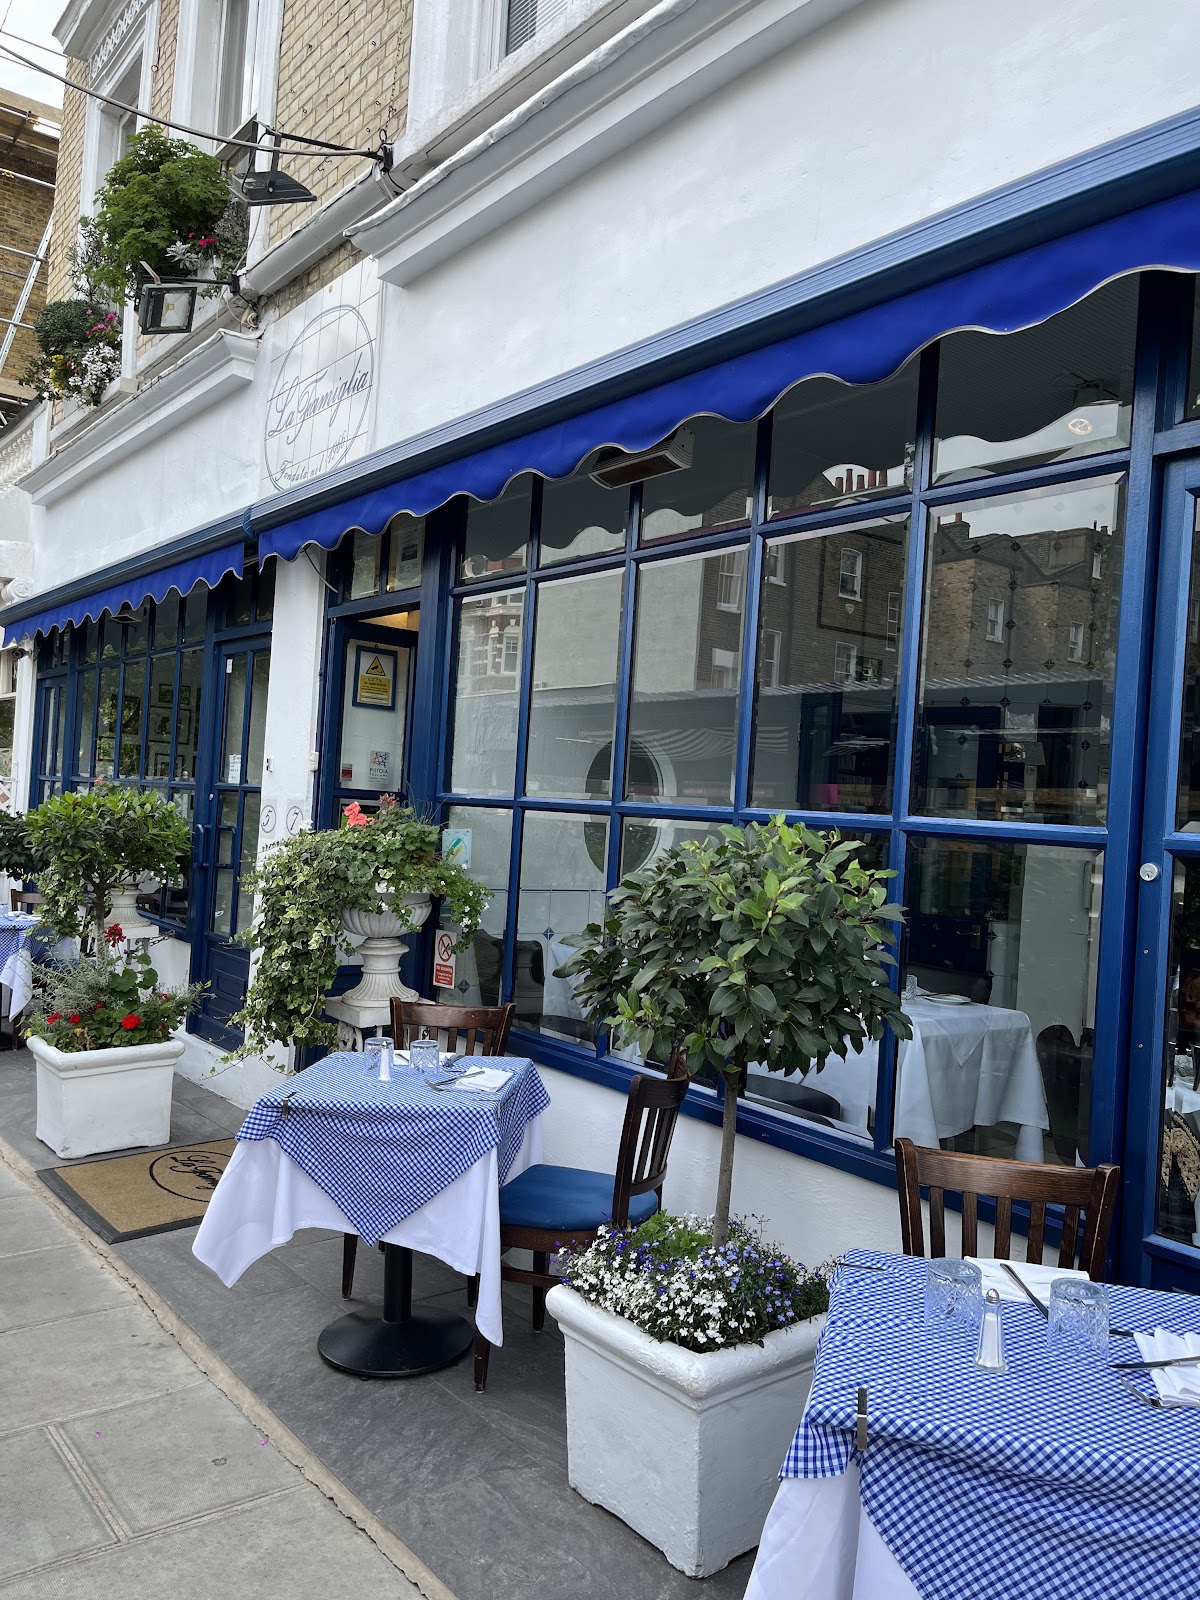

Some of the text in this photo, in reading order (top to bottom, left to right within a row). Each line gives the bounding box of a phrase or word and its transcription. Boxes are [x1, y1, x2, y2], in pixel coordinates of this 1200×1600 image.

[267, 351, 370, 446] La Famiglia
[309, 454, 323, 478] nel
[328, 429, 346, 463] 1966
[263, 810, 299, 830] 5 7
